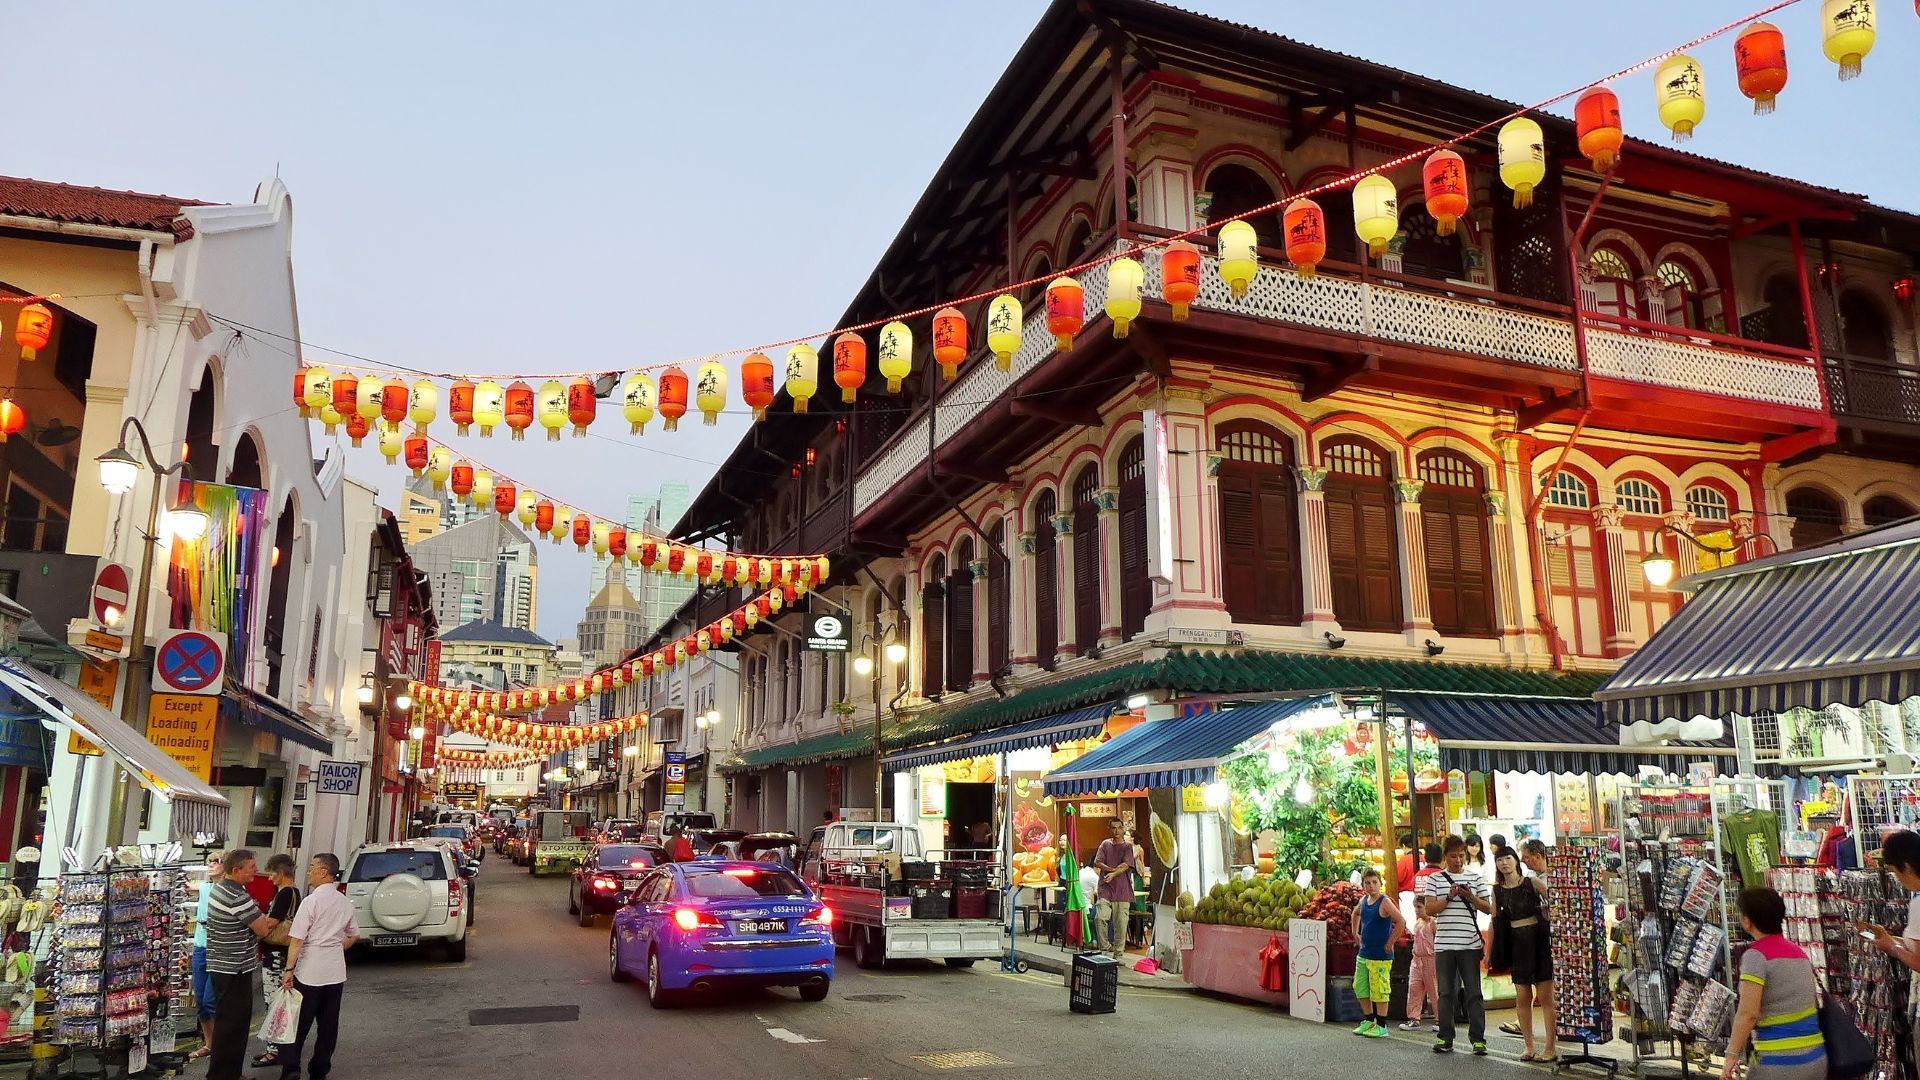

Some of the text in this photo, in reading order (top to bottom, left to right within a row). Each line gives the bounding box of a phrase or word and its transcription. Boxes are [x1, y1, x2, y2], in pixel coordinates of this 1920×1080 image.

[165, 698, 203, 714] Except
[152, 716, 197, 733] Loading
[150, 734, 209, 751] Unloading
[120, 770, 128, 782] 2
[322, 765, 358, 778] TAILOR
[323, 779, 353, 791] SHOP
